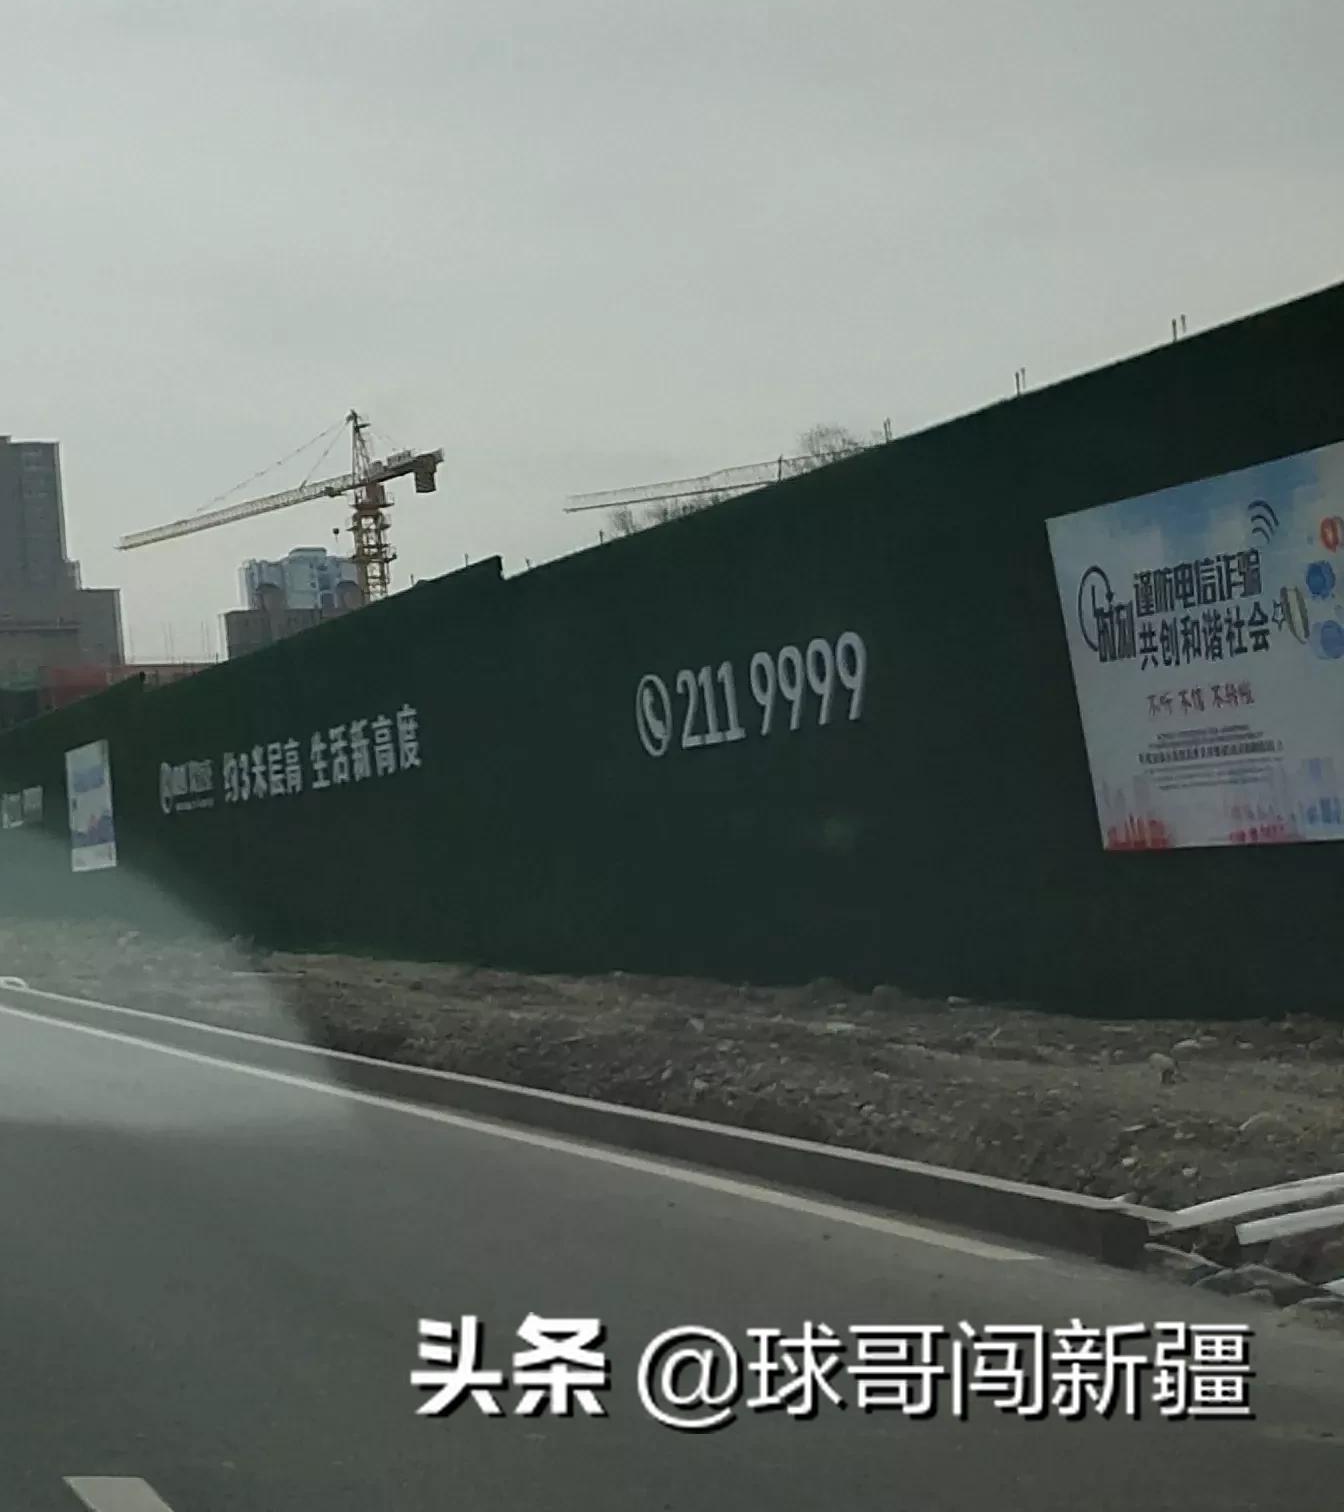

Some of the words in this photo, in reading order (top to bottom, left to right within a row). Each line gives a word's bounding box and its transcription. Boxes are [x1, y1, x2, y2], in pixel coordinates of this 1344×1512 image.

[1134, 548, 1262, 618] 谨防电信诈骗
[1139, 601, 1270, 670] 共创和谐社会
[676, 660, 746, 750] 211
[750, 631, 867, 737] 9999
[310, 703, 421, 790] 生活新高度
